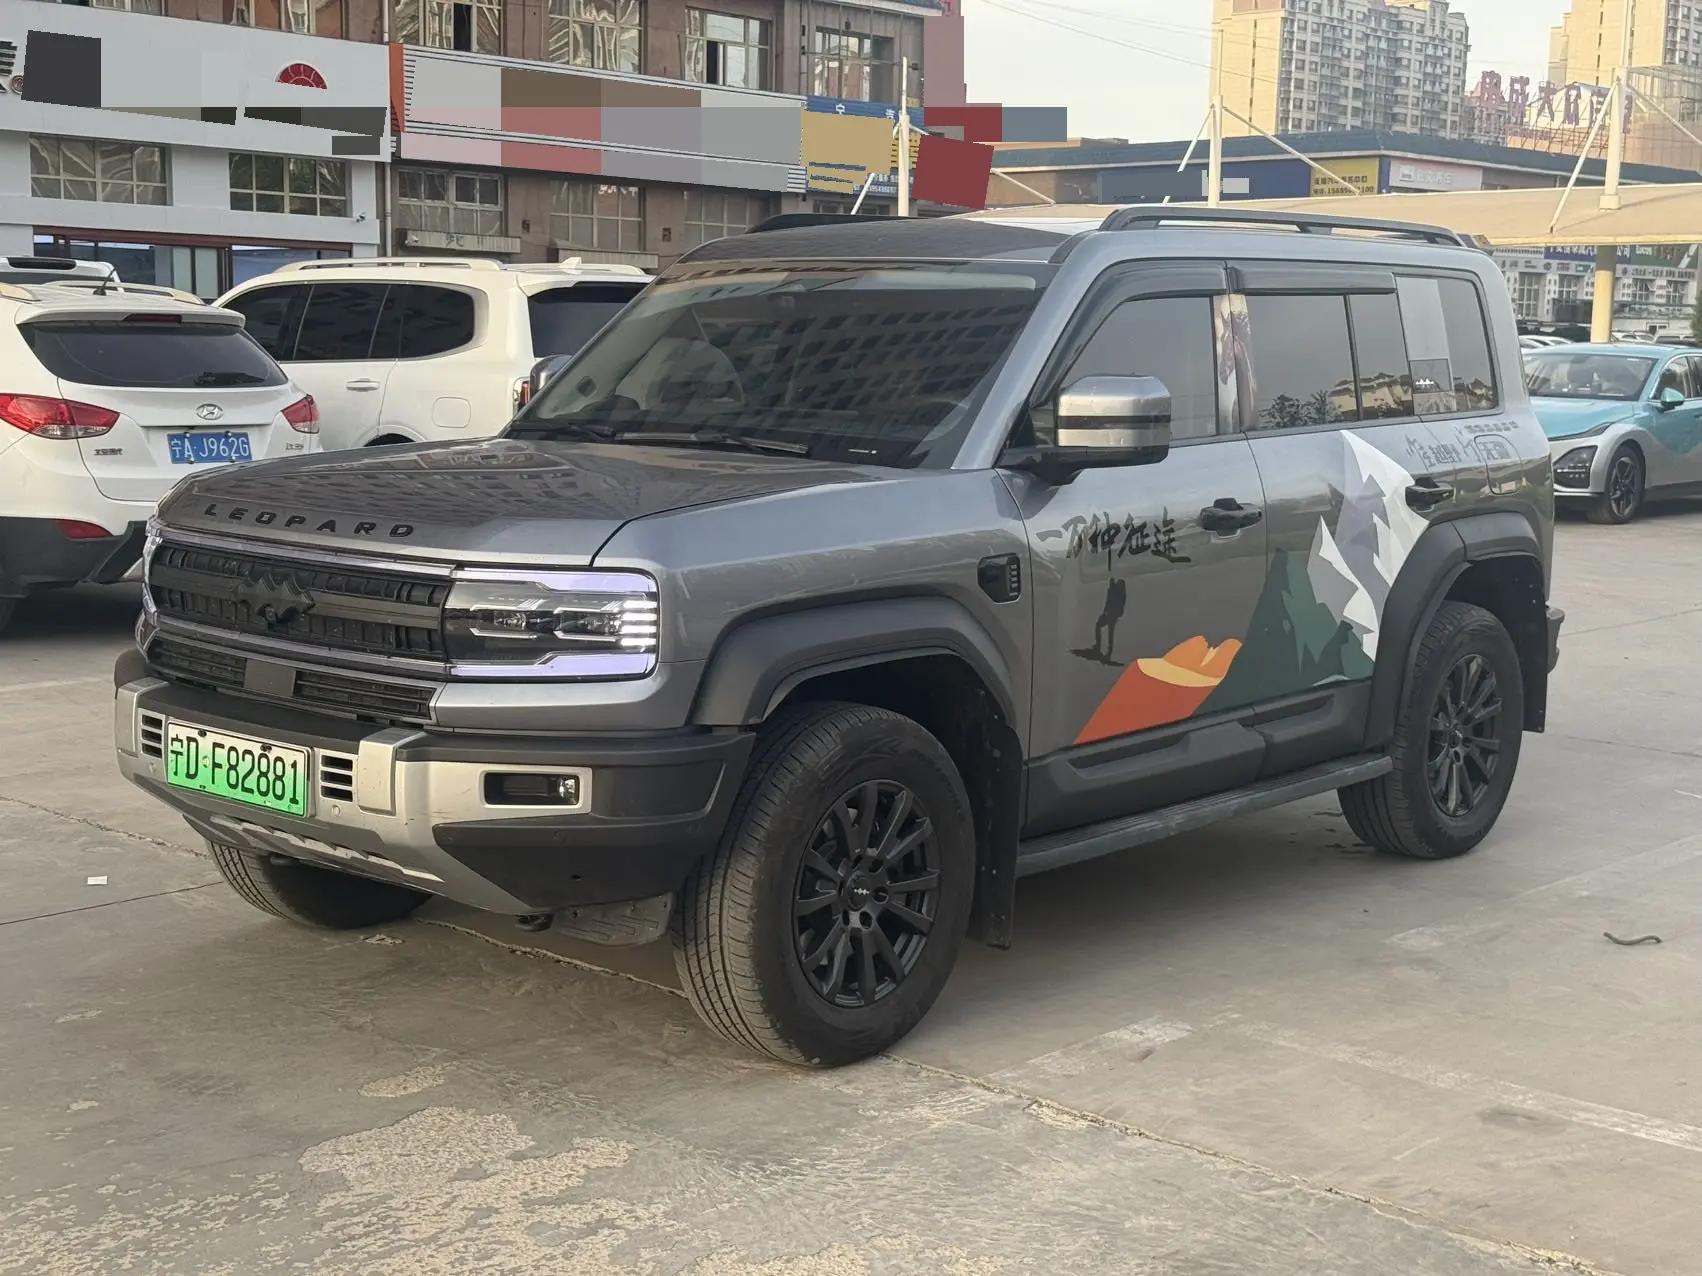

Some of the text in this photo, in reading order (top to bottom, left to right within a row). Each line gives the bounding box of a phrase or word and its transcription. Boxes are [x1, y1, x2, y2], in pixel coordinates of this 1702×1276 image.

[204, 503, 414, 537] LEOPARD
[1035, 505, 1192, 572] 一万种征途
